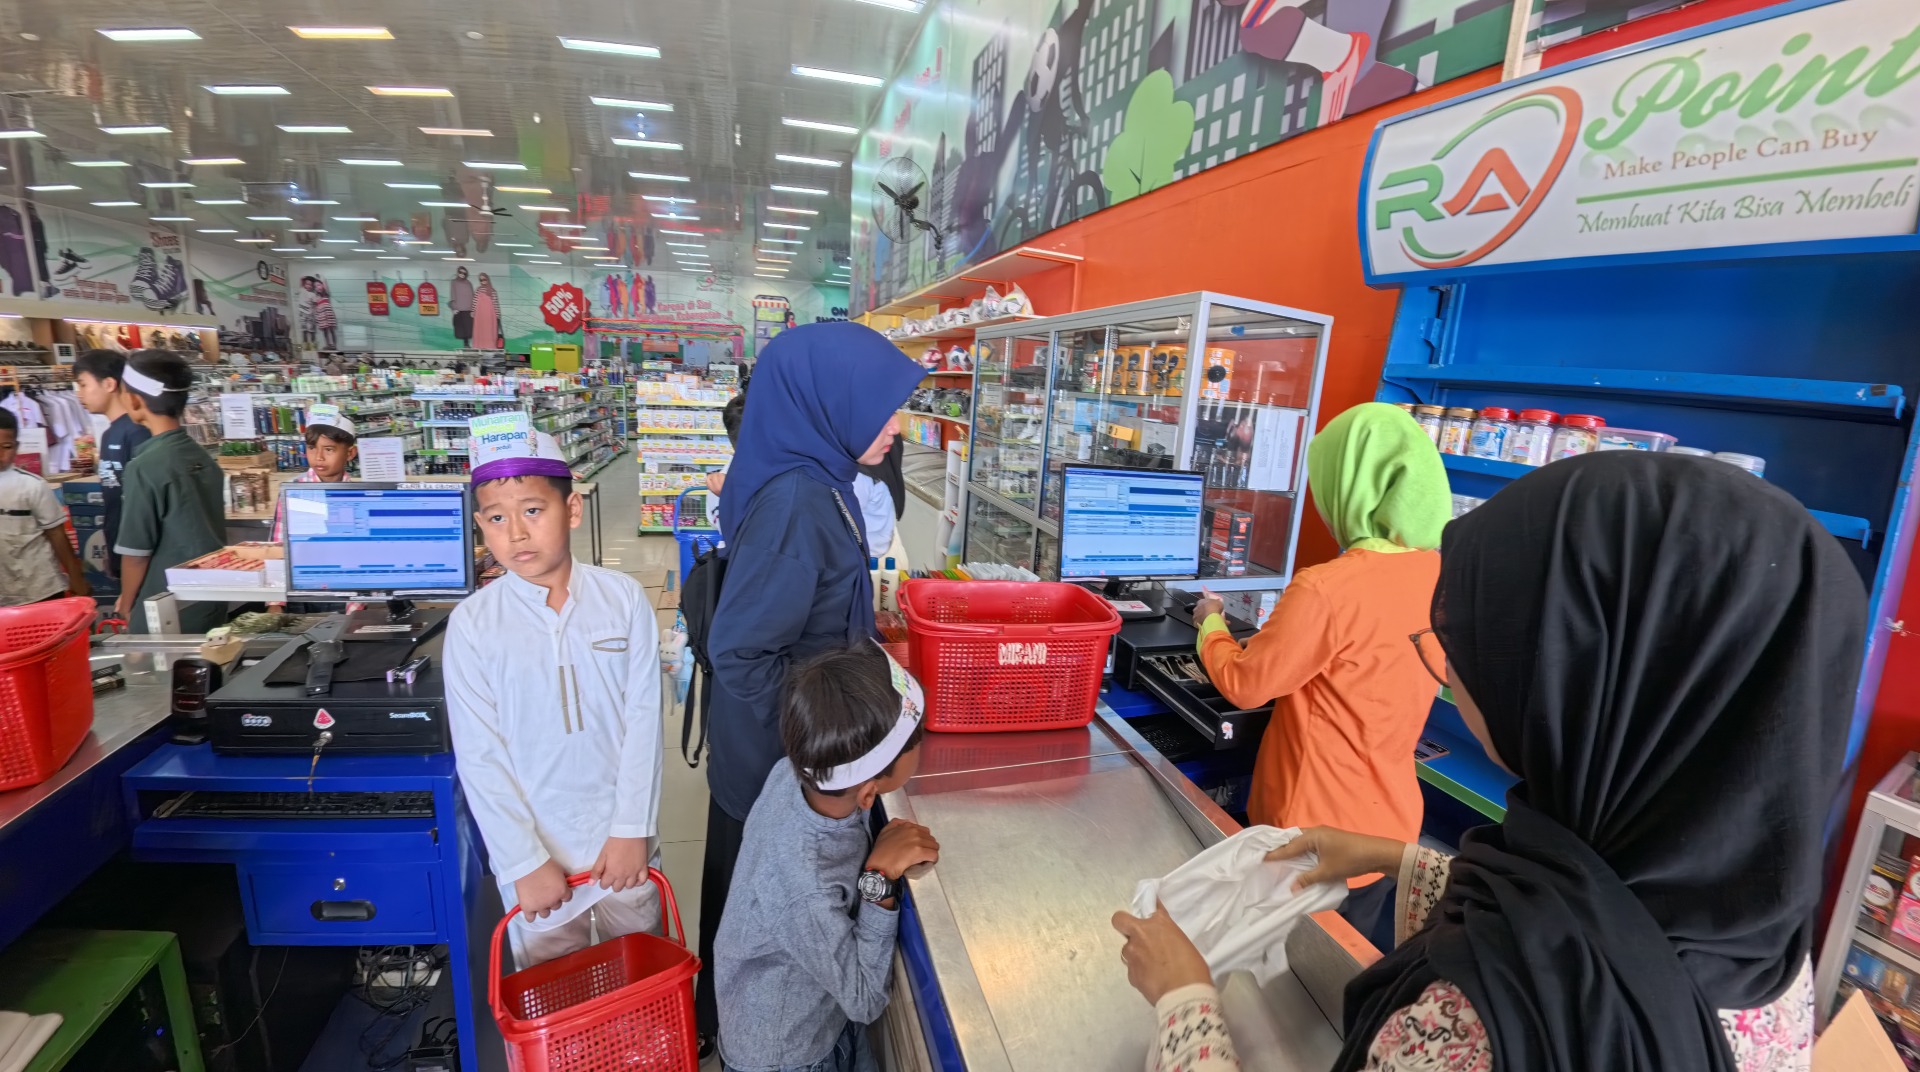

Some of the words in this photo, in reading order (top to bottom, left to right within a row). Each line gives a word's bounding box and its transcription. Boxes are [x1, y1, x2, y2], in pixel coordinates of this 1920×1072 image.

[1583, 24, 1920, 151] Point
[1603, 156, 1662, 180] Make
[1671, 142, 1748, 170] People
[1757, 136, 1810, 159] Can
[1821, 128, 1880, 152] Buy
[1376, 147, 1531, 231] RA
[1577, 203, 1671, 234] Membuat
[1677, 199, 1726, 224] Kita
[1734, 195, 1784, 219] Bisa
[1795, 175, 1915, 215] Membeli
[544, 287, 573, 315] 50%
[560, 302, 580, 322] OFF
[481, 431, 528, 445] Harapan
